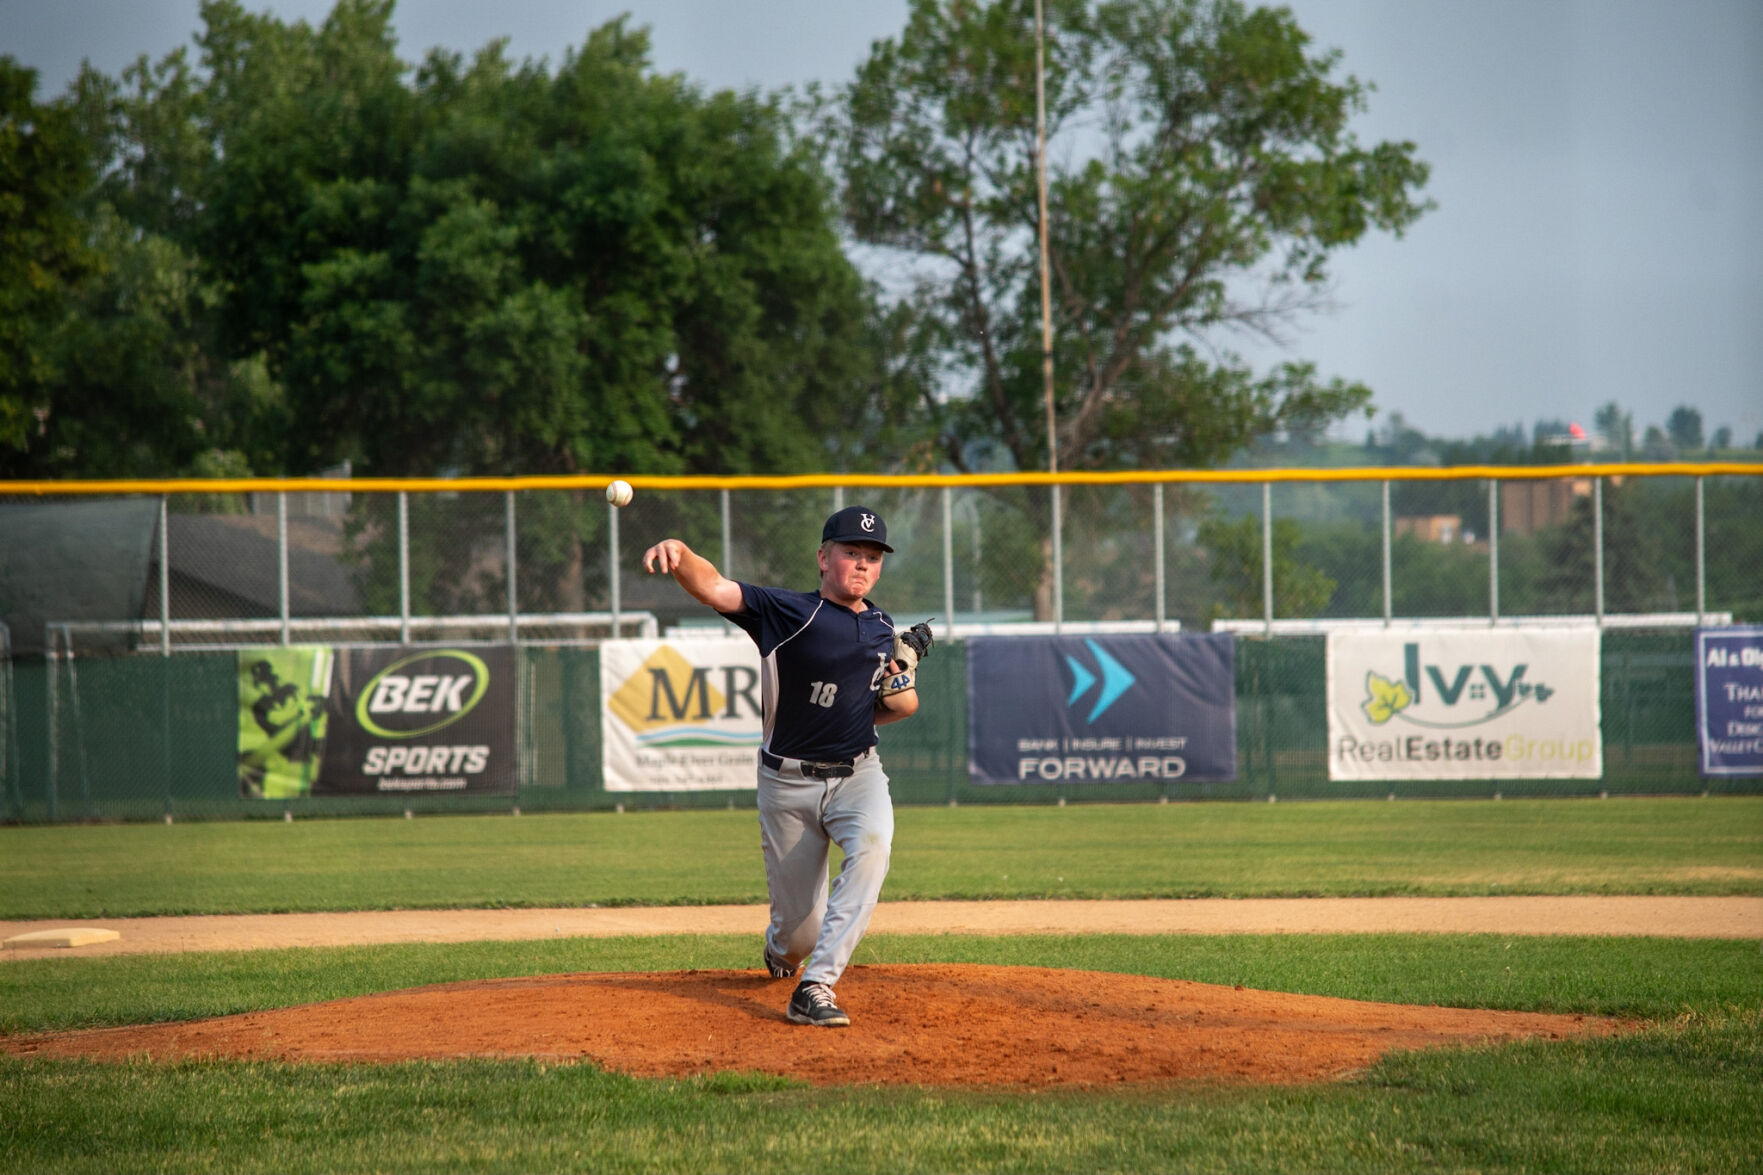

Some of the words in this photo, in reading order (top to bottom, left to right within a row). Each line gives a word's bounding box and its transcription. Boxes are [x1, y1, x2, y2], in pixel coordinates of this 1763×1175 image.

[1403, 642, 1528, 716] Ivy
[369, 675, 472, 713] BEK
[809, 681, 838, 708] 18
[1072, 737, 1122, 750] INSURE
[1135, 736, 1187, 750] INVEST
[1338, 735, 1594, 763] RealEstateGroup
[363, 745, 490, 775] SPORTS
[1018, 757, 1186, 780] FORWARD
